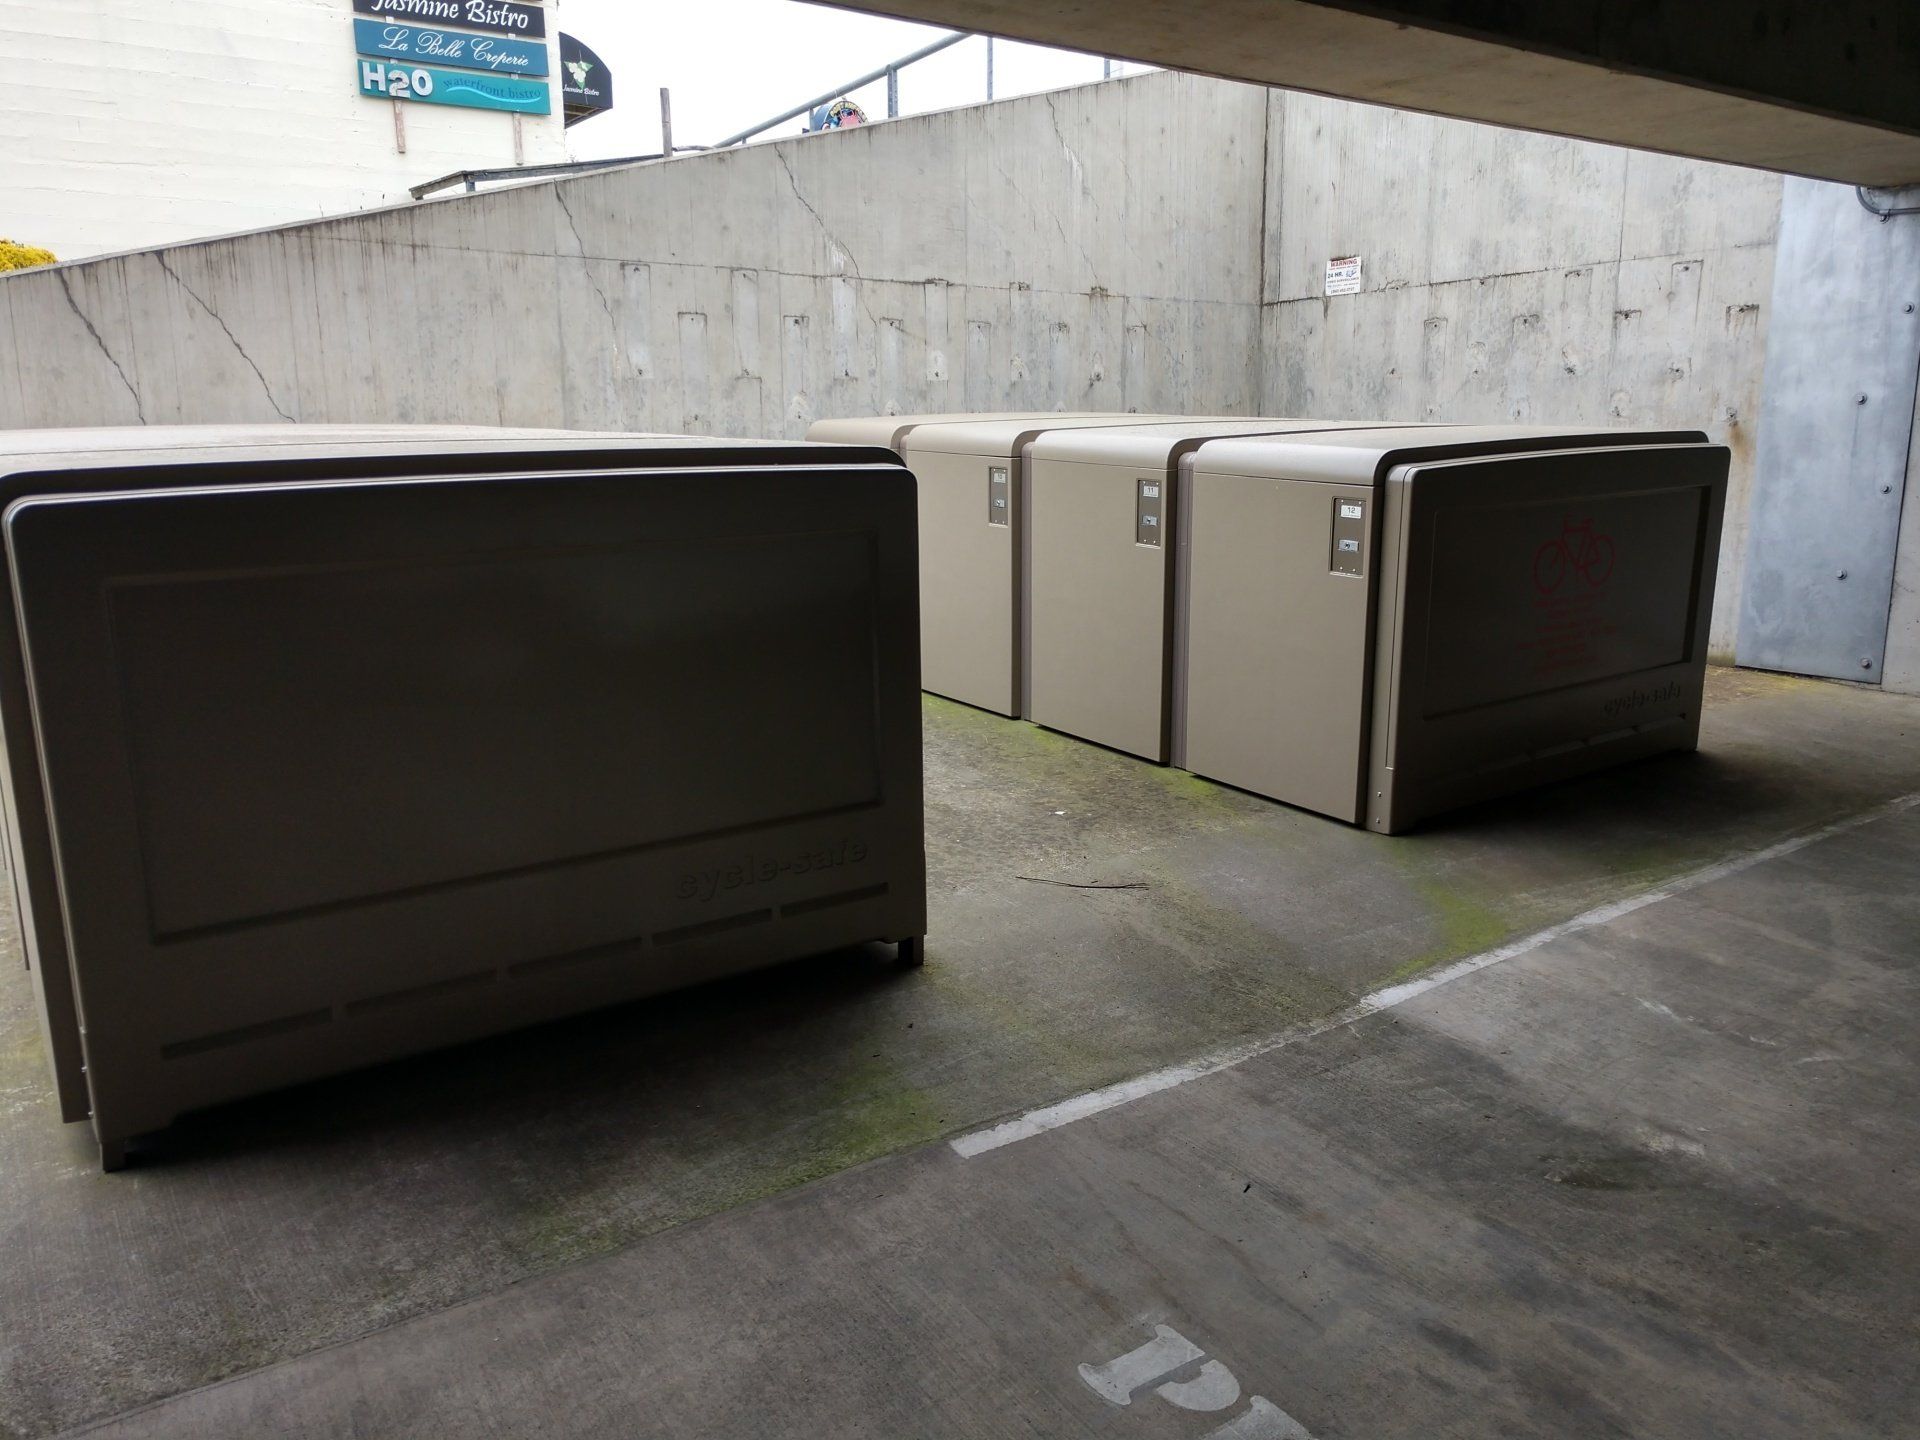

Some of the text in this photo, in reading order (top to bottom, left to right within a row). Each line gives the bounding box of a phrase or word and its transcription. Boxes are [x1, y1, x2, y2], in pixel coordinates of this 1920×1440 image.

[465, 1, 529, 29] Bistro
[379, 26, 529, 69] La Belle Creperie
[443, 77, 505, 97] waterfront
[507, 86, 541, 98] bistro
[1331, 259, 1357, 267] WARNING
[677, 839, 868, 902] cycle-safe
